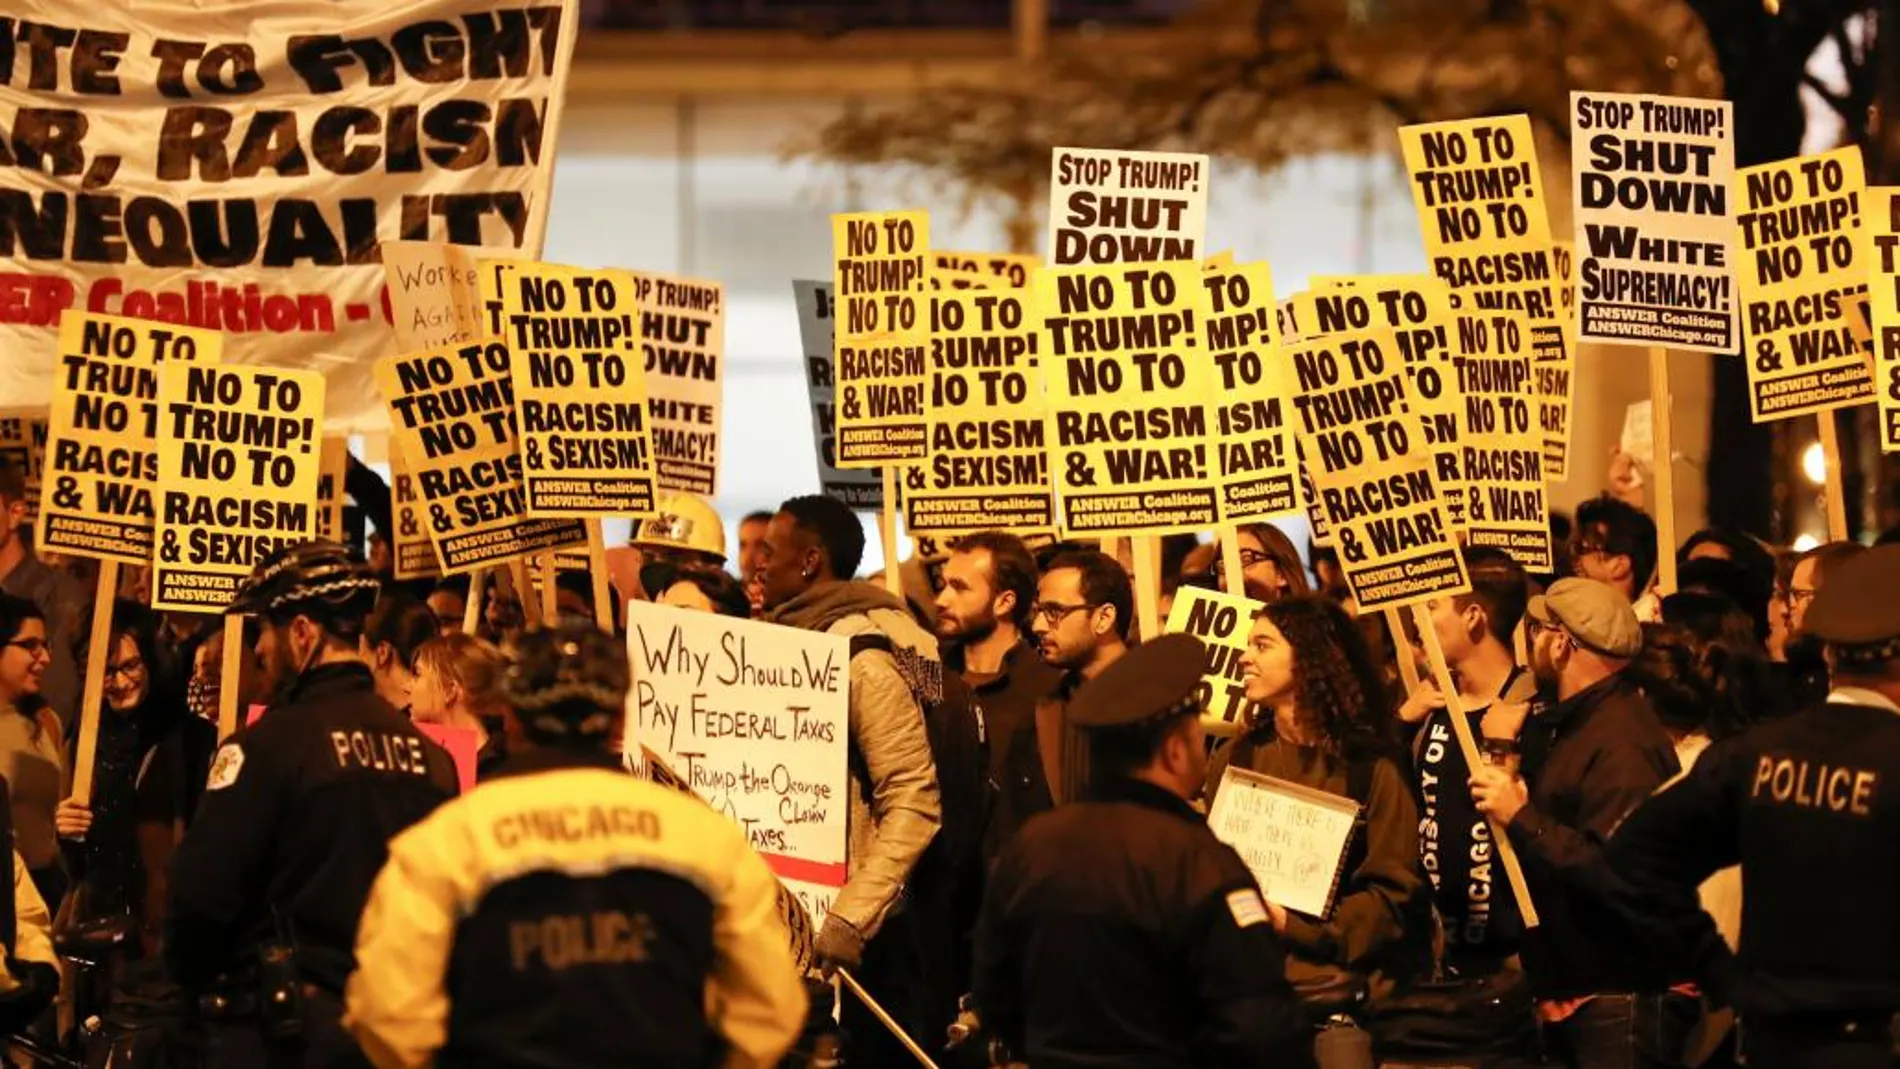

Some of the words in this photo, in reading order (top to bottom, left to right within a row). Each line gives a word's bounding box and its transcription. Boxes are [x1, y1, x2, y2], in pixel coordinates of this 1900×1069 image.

[0, 17, 130, 95] TE
[151, 39, 264, 98] TO
[1577, 97, 1633, 130] STOP
[1640, 101, 1725, 139] TRUMP!
[1419, 131, 1466, 168] NO
[1473, 127, 1515, 160] TO
[1589, 134, 1716, 178] SHUT
[1059, 153, 1113, 186] STOP
[1118, 158, 1200, 192] TRUMP!
[1416, 162, 1533, 207] TRUMP!
[1746, 170, 1793, 210] NO
[1801, 159, 1843, 198] TO
[1067, 191, 1188, 231] SHUT
[1581, 172, 1726, 217] DOWN
[848, 220, 877, 257] NO
[884, 219, 914, 255] TO
[1437, 206, 1482, 243] NO
[1487, 203, 1529, 240] TO
[1737, 191, 1861, 249] TRUMP!
[1054, 228, 1195, 264] DOWN
[1584, 224, 1725, 268] WHITE
[1756, 247, 1802, 286] NO
[1810, 235, 1853, 273] TO
[396, 261, 478, 293] Worke
[839, 256, 924, 296] TRUMP!
[1435, 250, 1551, 289] RACISM
[1581, 258, 1730, 312] SUPREMACY!
[520, 277, 565, 312] NO
[573, 277, 617, 312] TO
[656, 280, 720, 315] TRUMP!
[1057, 275, 1114, 314] NO
[1124, 271, 1177, 310] TO
[1203, 274, 1250, 313] TO
[1315, 295, 1369, 333] NO
[1377, 290, 1427, 327] TO
[510, 314, 632, 350] TRUMP!
[638, 311, 713, 346] HUT
[848, 298, 877, 334] NO
[885, 296, 915, 333] TO
[975, 297, 1022, 333] TO
[1045, 309, 1197, 355] TRUMP!
[1587, 306, 1658, 323] ANSWER
[1662, 312, 1726, 330] Coalition
[1588, 321, 1726, 346] ANSWERChicago.org
[83, 320, 136, 360] NO
[149, 330, 195, 365] TO
[932, 332, 1039, 369] RUMP!
[1457, 317, 1485, 354] NO
[1492, 316, 1520, 355] TO
[396, 357, 453, 393] NO
[458, 343, 510, 381] TO
[528, 353, 574, 388] NO
[582, 353, 625, 388] TO
[840, 346, 926, 381] RACISM
[1066, 357, 1122, 397] NO
[1132, 353, 1186, 392] TO
[1215, 352, 1262, 390] TO
[1293, 349, 1338, 392] NO
[1340, 339, 1384, 380] TO
[1755, 338, 1783, 373] &
[63, 355, 157, 399] TRUM
[187, 368, 242, 405] NO
[254, 374, 301, 412] TO
[978, 372, 1027, 408] TO
[1453, 357, 1533, 395] TRUMP!
[1760, 378, 1819, 397] ANSWER
[73, 395, 128, 432] NO
[391, 379, 515, 429] TRUM
[522, 400, 643, 432] RACISM
[648, 398, 714, 424] HITE
[842, 386, 862, 420] &
[867, 383, 924, 419] WAR!
[1292, 374, 1410, 434] TRUMP!
[1466, 397, 1495, 434] NO
[1498, 396, 1529, 434] TO
[169, 403, 314, 454] TRUMP!
[419, 421, 476, 460] NO
[932, 419, 1045, 451] ACISM
[1056, 405, 1206, 447] RACISM
[55, 438, 157, 481] RACIS
[181, 442, 236, 480] NO
[248, 449, 295, 487] TO
[526, 437, 544, 470] &
[548, 436, 650, 471] SEXISM!
[1064, 451, 1097, 487] &
[1103, 444, 1208, 486] WAR!
[1317, 430, 1363, 473] NO
[1365, 420, 1409, 461] TO
[1463, 446, 1541, 481] RACISM
[418, 453, 522, 501] RACIS
[534, 480, 591, 494] ANSWER
[595, 483, 649, 495] Coalition
[906, 466, 926, 490] &
[932, 452, 1049, 490] SEXISM!
[52, 476, 83, 509] &
[95, 480, 155, 518] WA
[913, 499, 980, 513] ANSWER
[983, 497, 1047, 511] Coalition
[1070, 497, 1141, 511] ANSWER
[1145, 494, 1212, 509] Coalition
[1230, 482, 1289, 500] Coalition
[1321, 469, 1436, 525] RACISM
[1469, 486, 1485, 521] &
[1488, 487, 1544, 524] WAR!
[51, 518, 123, 537] ANSWER
[163, 491, 307, 532] RACISM
[429, 503, 452, 533] &
[160, 528, 180, 563] &
[447, 528, 514, 552] ANSWER
[1339, 527, 1367, 563] &
[1365, 507, 1447, 558] WAR!
[163, 574, 234, 589] ANSWER
[1353, 566, 1404, 588] ANSWER
[1405, 556, 1456, 579] Coalition
[1185, 598, 1238, 638] NO
[637, 623, 709, 687] Why
[691, 693, 787, 742] FEDERAL
[331, 731, 426, 774] POLICE
[1425, 723, 1450, 764] OF
[739, 761, 769, 794] the
[1752, 755, 1876, 815] POLICE
[492, 806, 662, 849] CHICAGO
[1464, 821, 1493, 944] CHICAGO
